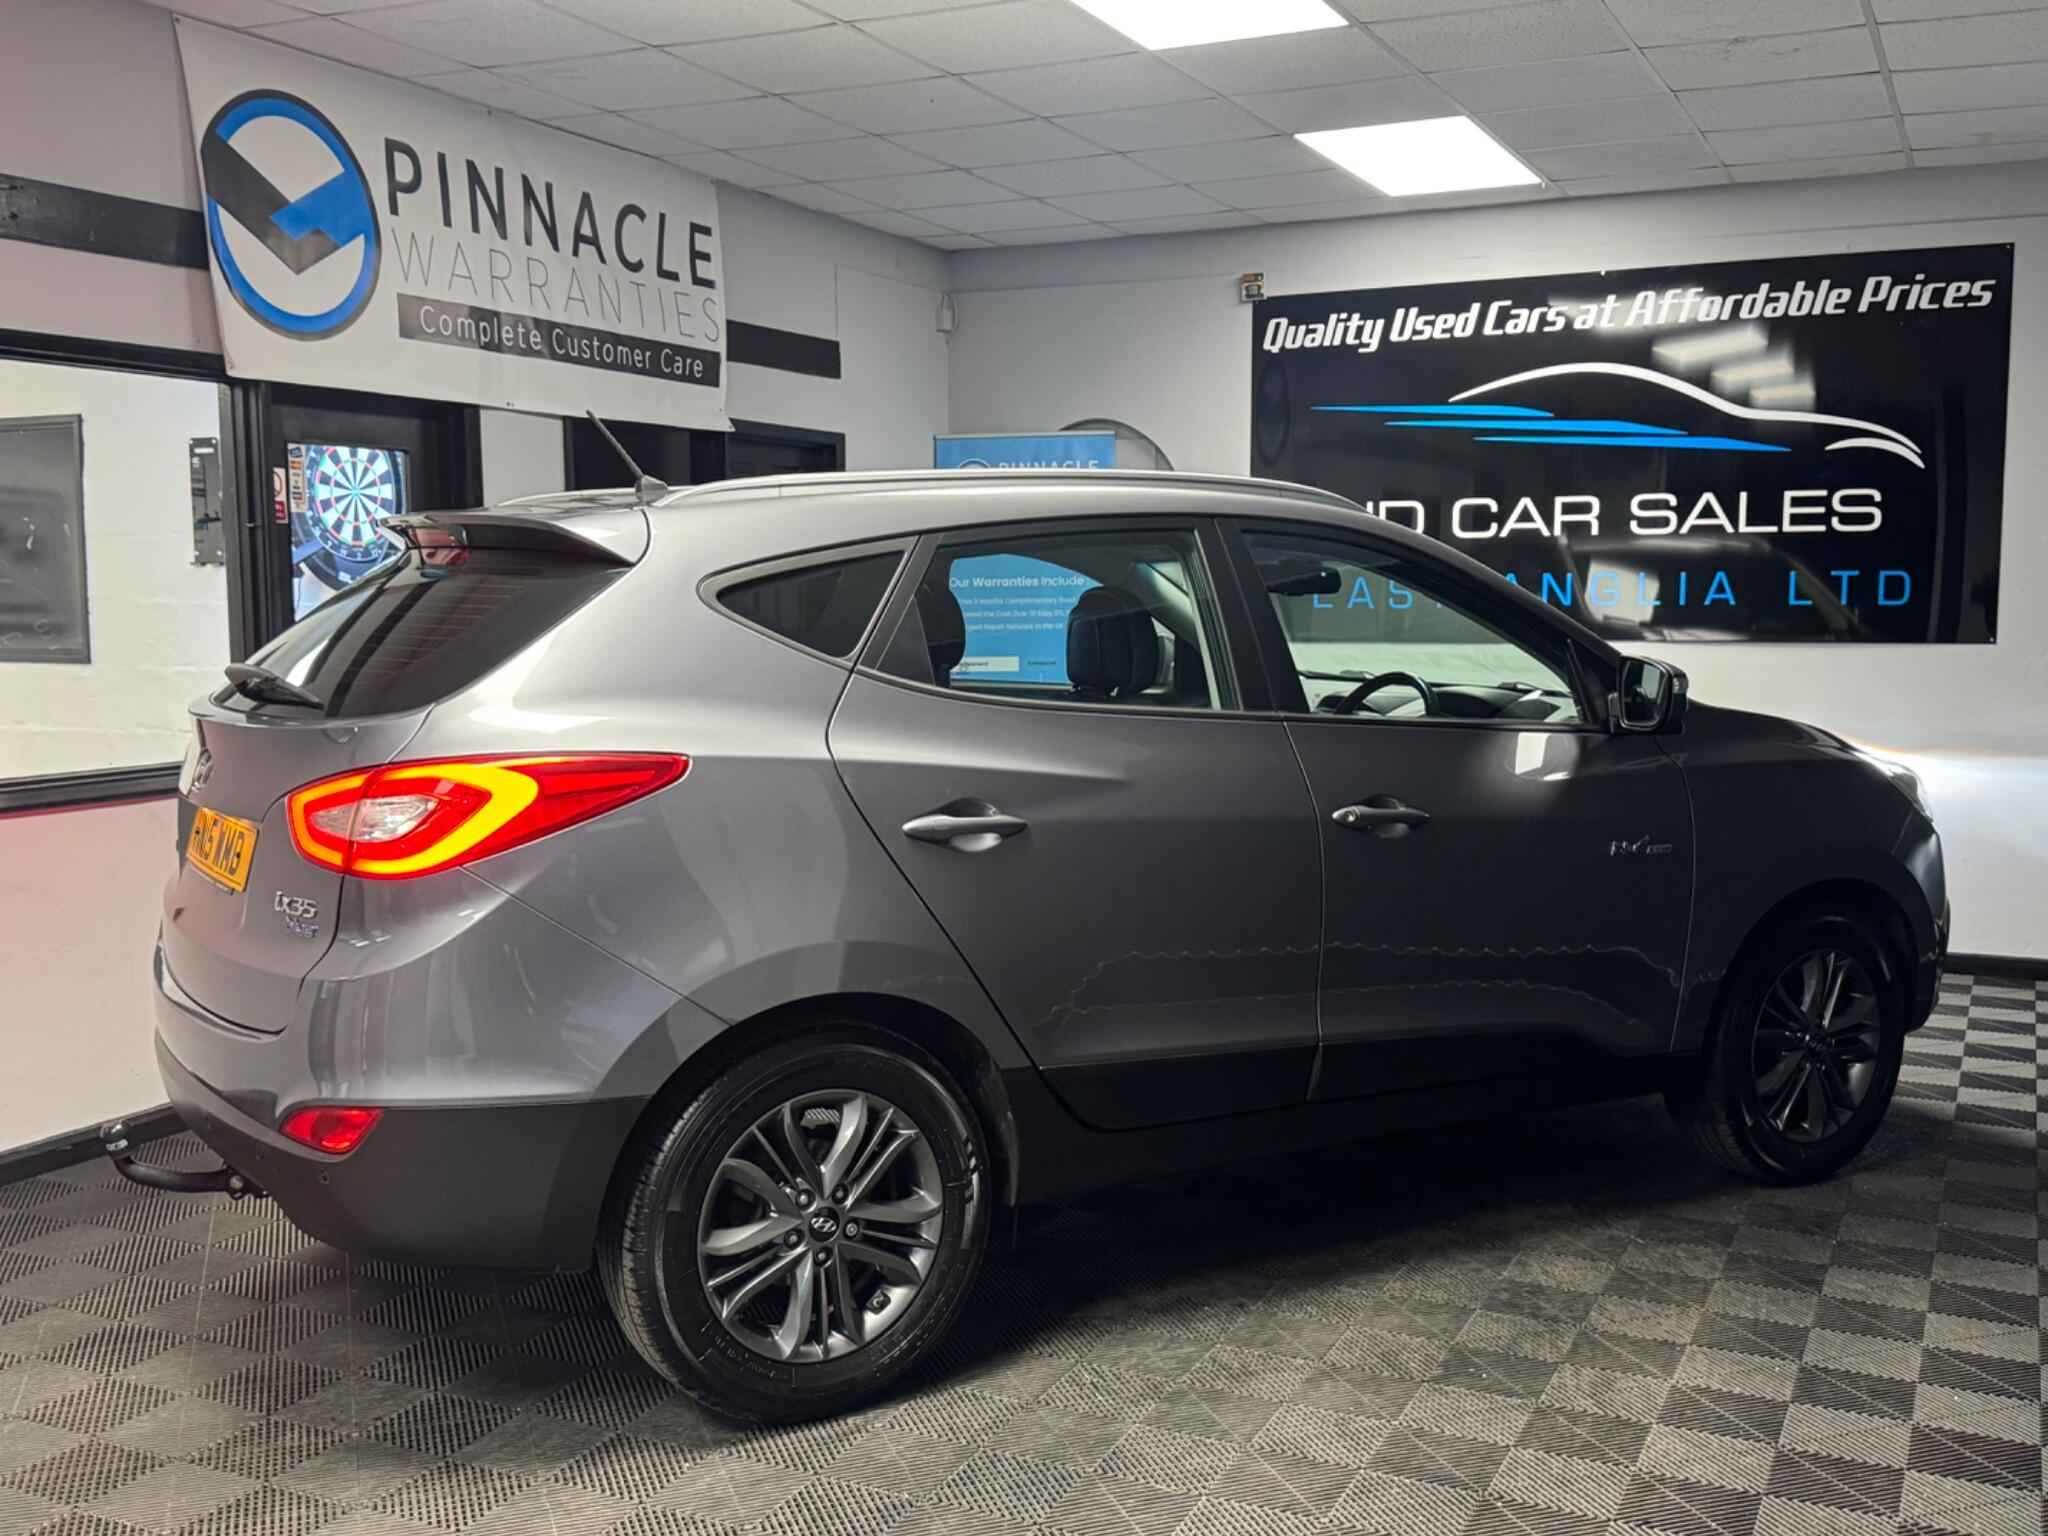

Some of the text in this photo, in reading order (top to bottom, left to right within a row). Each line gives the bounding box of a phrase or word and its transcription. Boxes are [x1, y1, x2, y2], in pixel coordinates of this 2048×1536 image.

[385, 137, 716, 289] PINNACLE
[391, 227, 720, 343] WARRANTIES
[1263, 274, 1996, 353] Quality Used Cars at Affordable Prices
[420, 305, 703, 378] Complete Customer Care
[1452, 495, 1600, 539] CAR
[1630, 488, 1882, 535] SALES
[949, 577, 970, 588] Our
[972, 576, 1039, 587] Warranties
[1041, 576, 1085, 586] Include
[1313, 570, 1911, 609] AS NGLIA LTD
[275, 891, 318, 919] ix35
